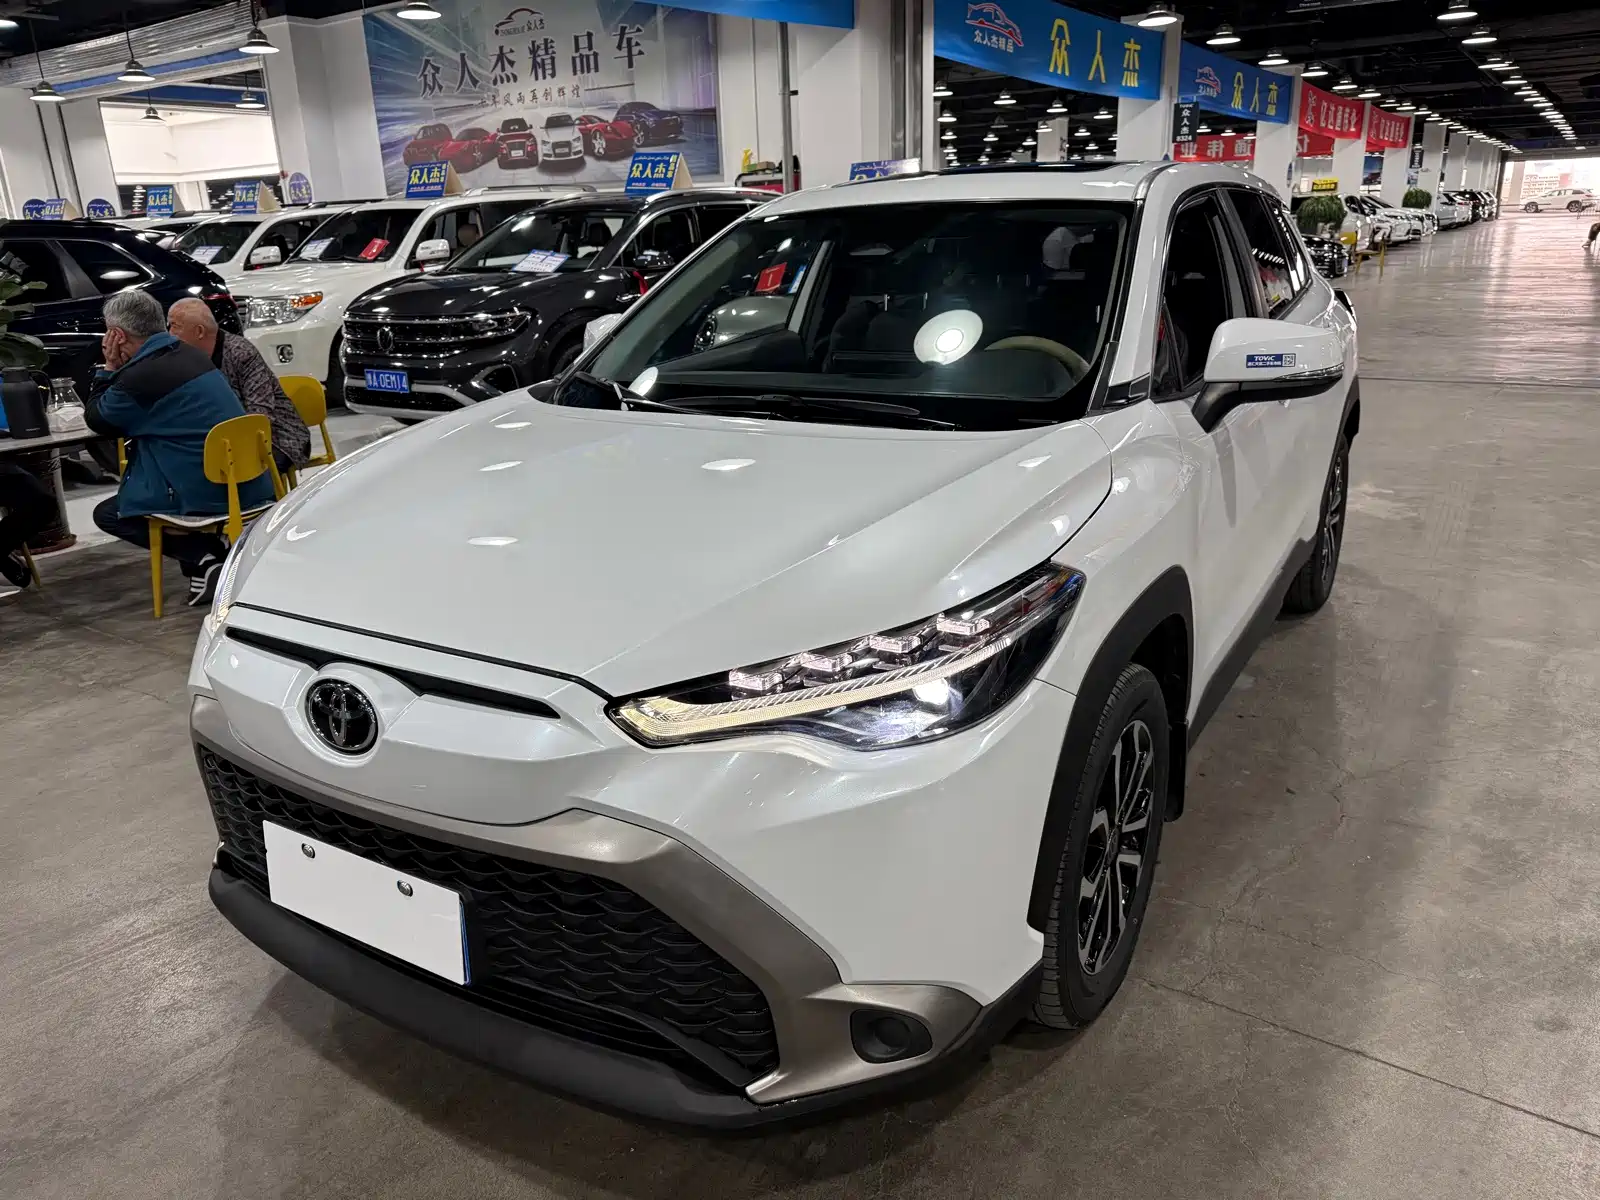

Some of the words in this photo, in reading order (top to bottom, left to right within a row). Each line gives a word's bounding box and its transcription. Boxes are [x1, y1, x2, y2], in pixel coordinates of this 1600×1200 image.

[417, 25, 645, 97] 众人杰精品车
[1049, 18, 1142, 88] 众人杰
[1230, 71, 1278, 117] 众人杰
[409, 167, 441, 184] 众人杰
[630, 162, 666, 179] 众人杰
